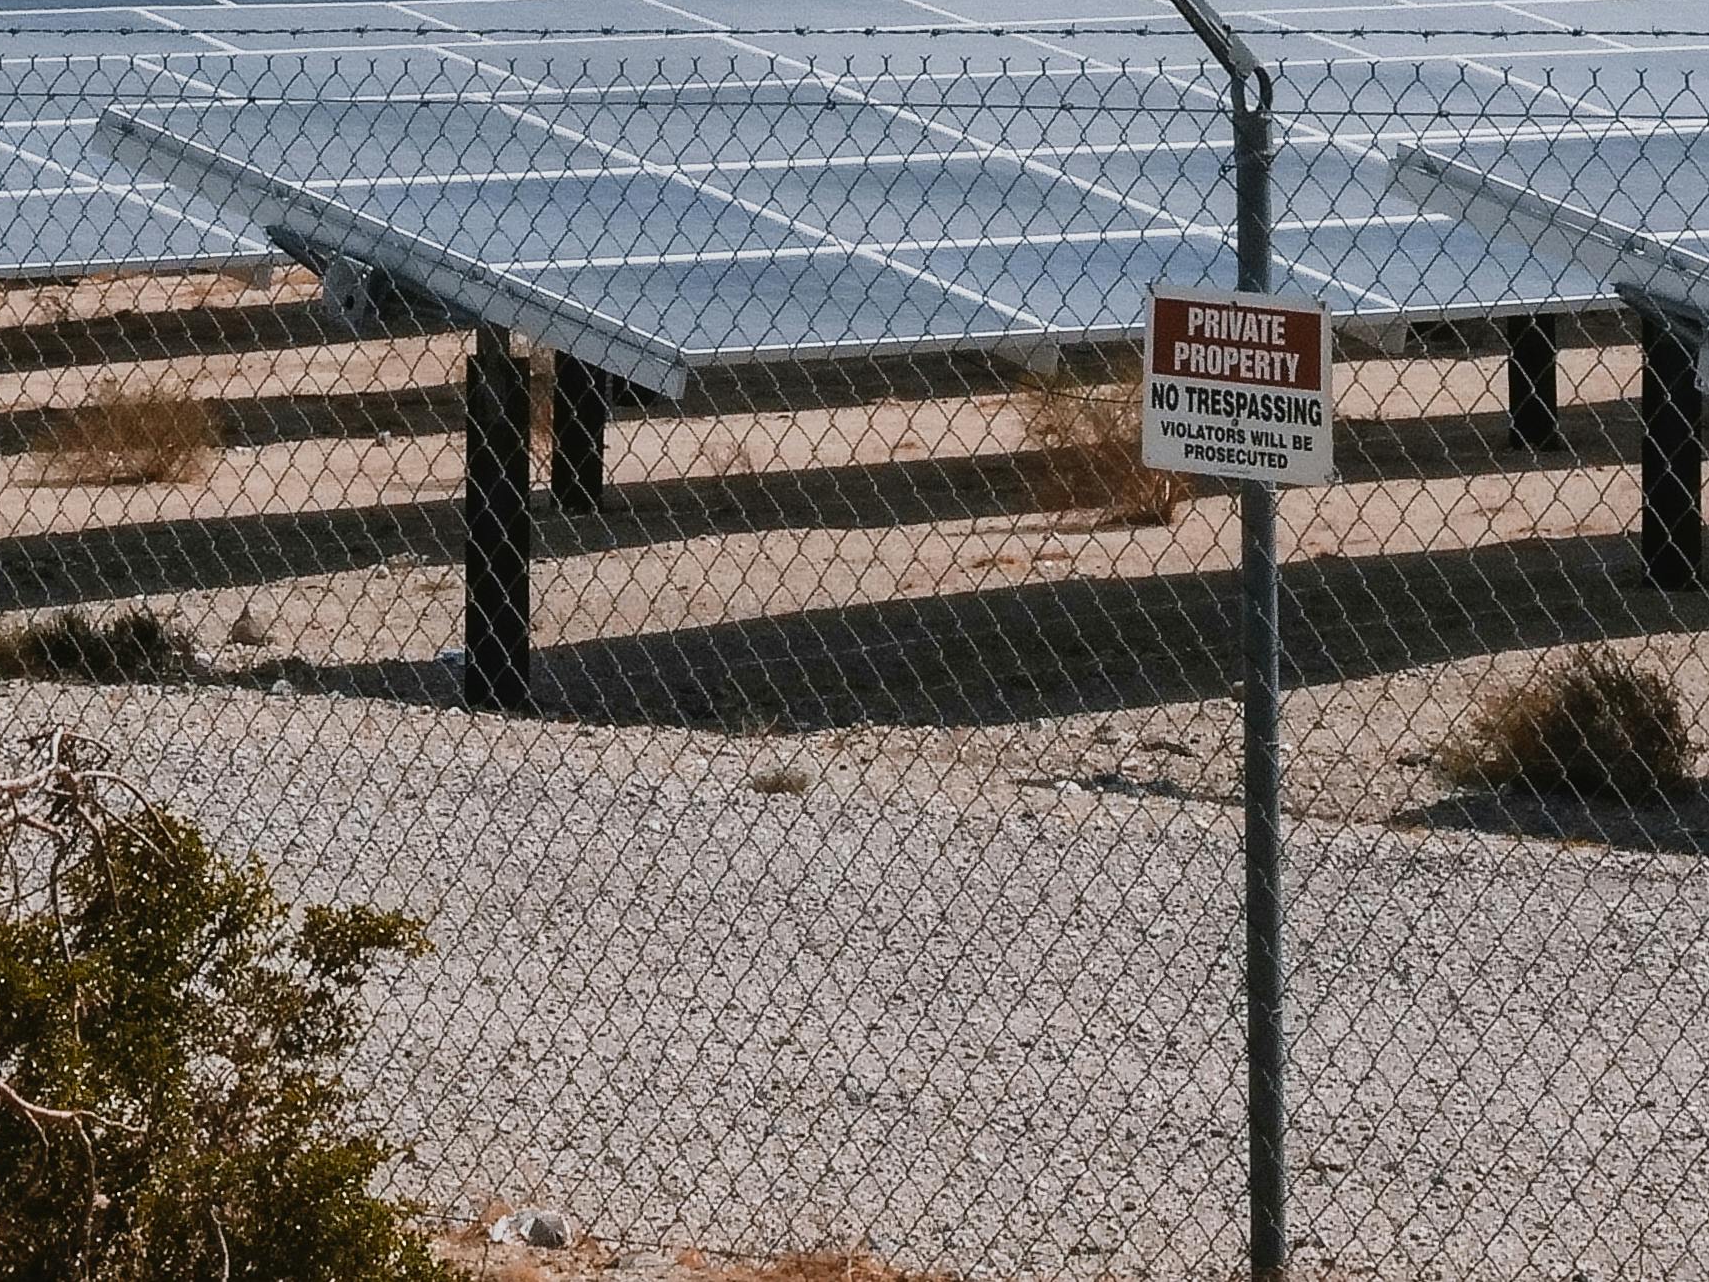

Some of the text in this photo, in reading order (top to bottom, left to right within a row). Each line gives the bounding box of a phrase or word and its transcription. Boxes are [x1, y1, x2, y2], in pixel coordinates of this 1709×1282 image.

[1187, 307, 1286, 345] PRIVATE
[1174, 341, 1300, 383] PROPERTY
[1151, 382, 1322, 427] NO TRESPASSING
[1160, 420, 1313, 451] VIOLATORS WILL BE
[1184, 444, 1288, 469] PROSECUTED
